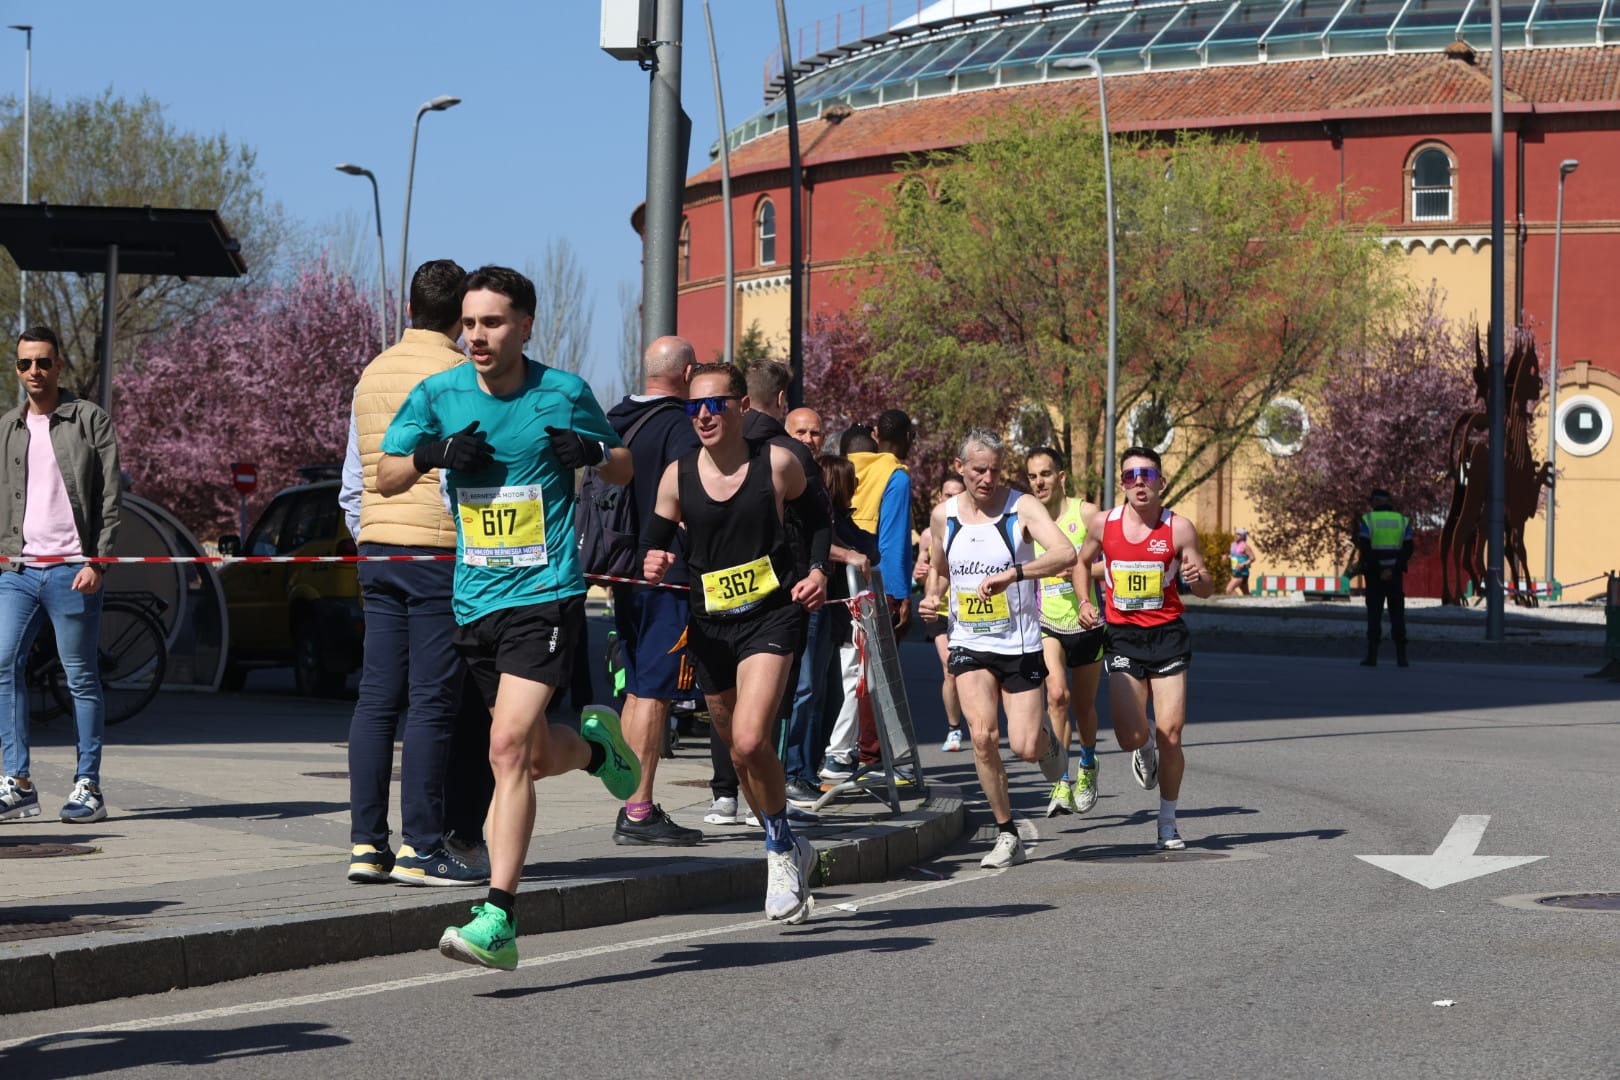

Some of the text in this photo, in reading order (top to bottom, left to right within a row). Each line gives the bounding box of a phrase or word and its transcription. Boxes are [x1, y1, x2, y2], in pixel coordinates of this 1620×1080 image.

[503, 491, 525, 499] MOTOR
[481, 508, 517, 536] 617
[718, 569, 759, 600] 362
[1128, 575, 1147, 591] 191
[966, 597, 994, 615] 226
